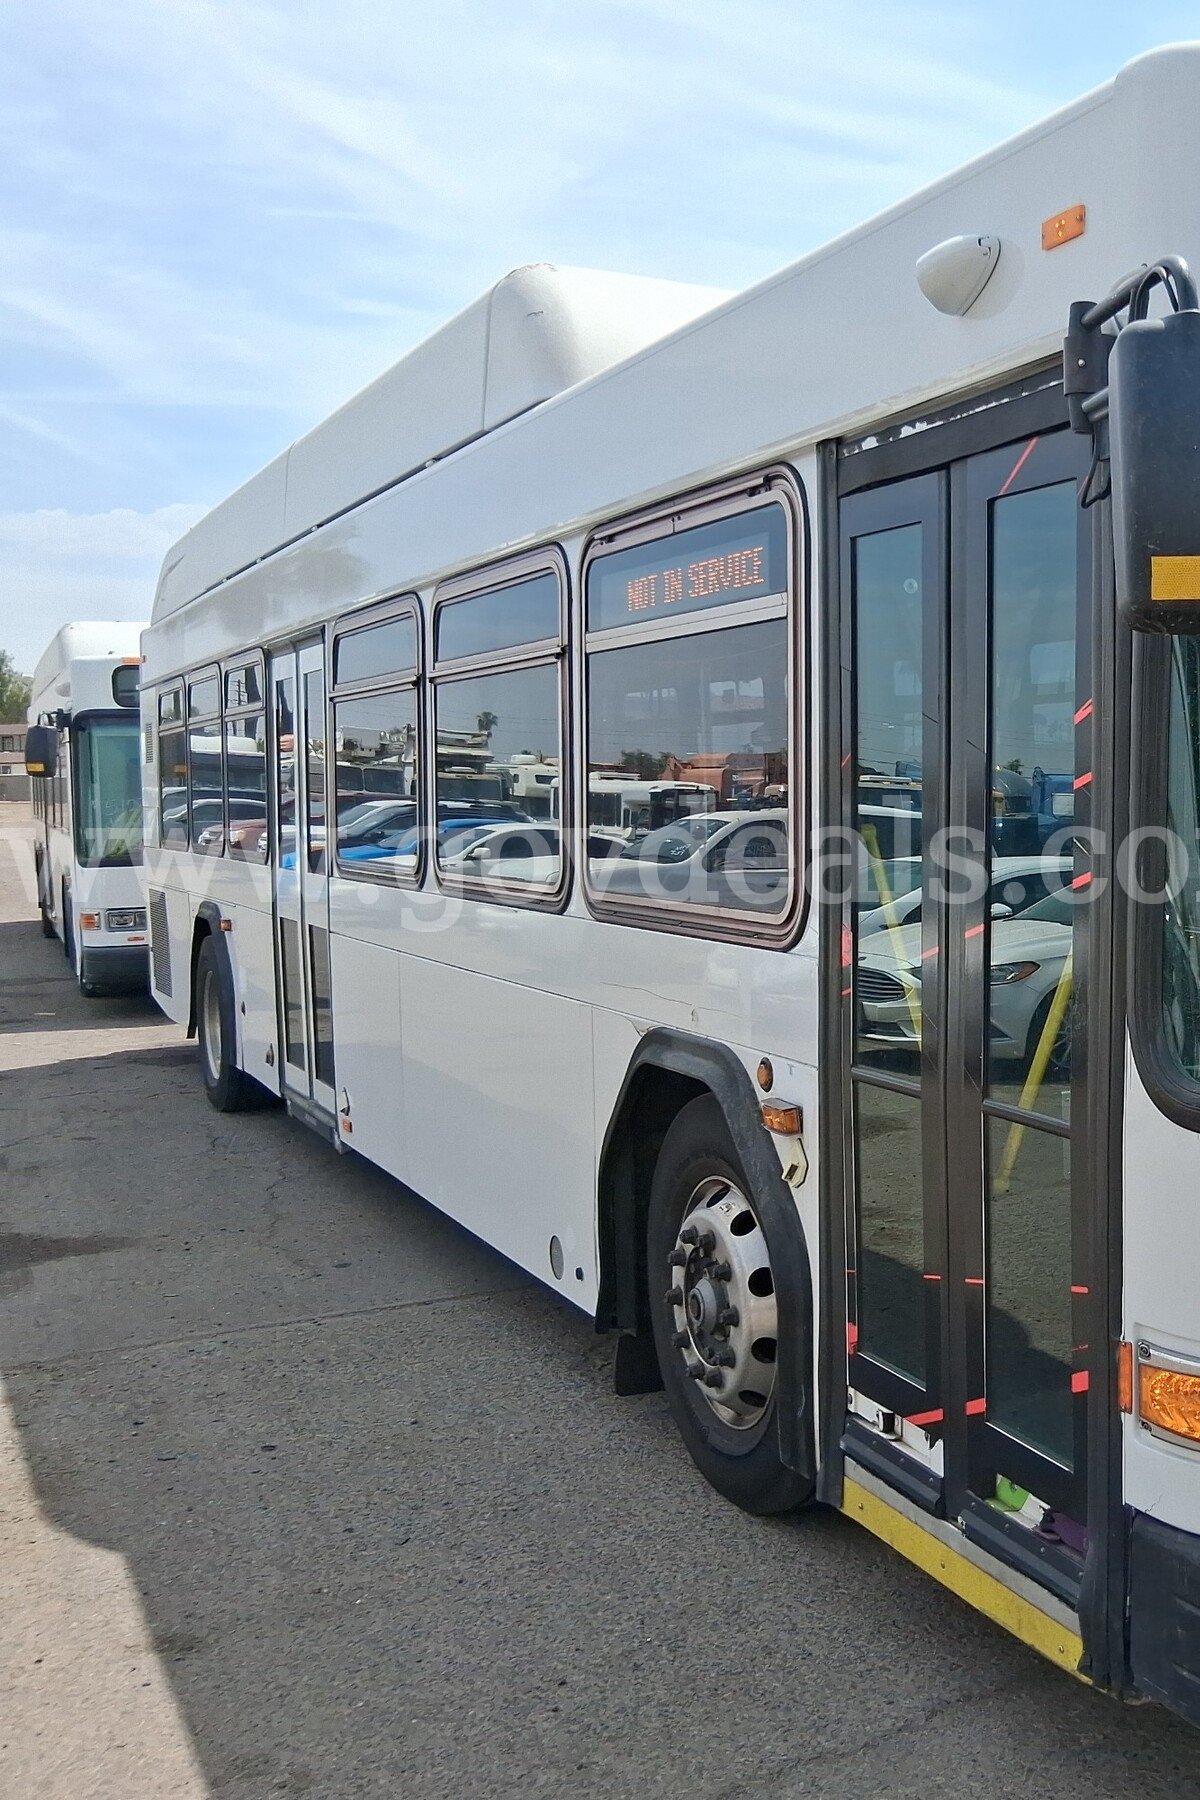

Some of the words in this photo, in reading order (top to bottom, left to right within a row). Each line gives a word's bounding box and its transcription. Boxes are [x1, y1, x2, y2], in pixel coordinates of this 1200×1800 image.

[627, 573, 659, 612] NOT
[663, 567, 682, 605] IN
[687, 546, 765, 598] SERVICE
